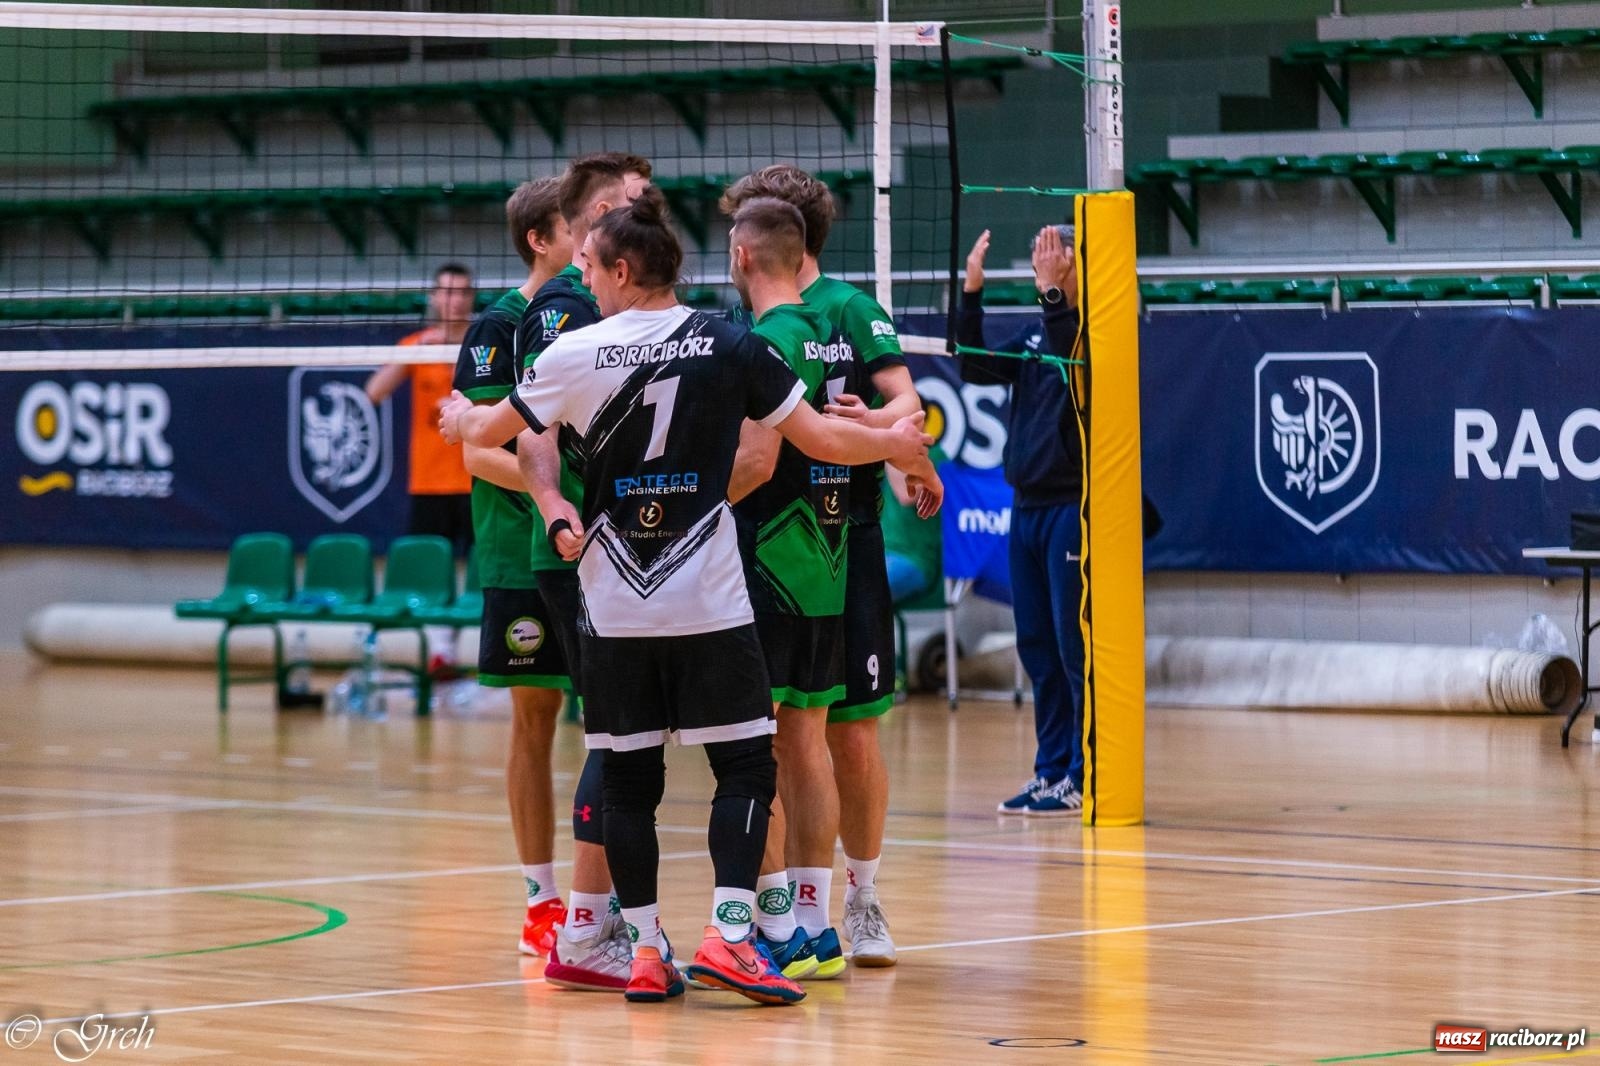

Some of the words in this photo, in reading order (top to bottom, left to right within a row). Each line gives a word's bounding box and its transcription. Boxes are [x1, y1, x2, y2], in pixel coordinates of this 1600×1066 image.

[543, 329, 560, 337] PCS
[595, 345, 624, 369] KS
[624, 329, 715, 367] RACIBÓRZ
[803, 340, 819, 361] KS
[475, 364, 491, 373] PCS
[914, 376, 1012, 470] OS
[1454, 408, 1600, 480] RAC
[630, 530, 656, 539] Studio
[867, 654, 879, 691] 9
[799, 884, 817, 901] R
[574, 907, 594, 923] R
